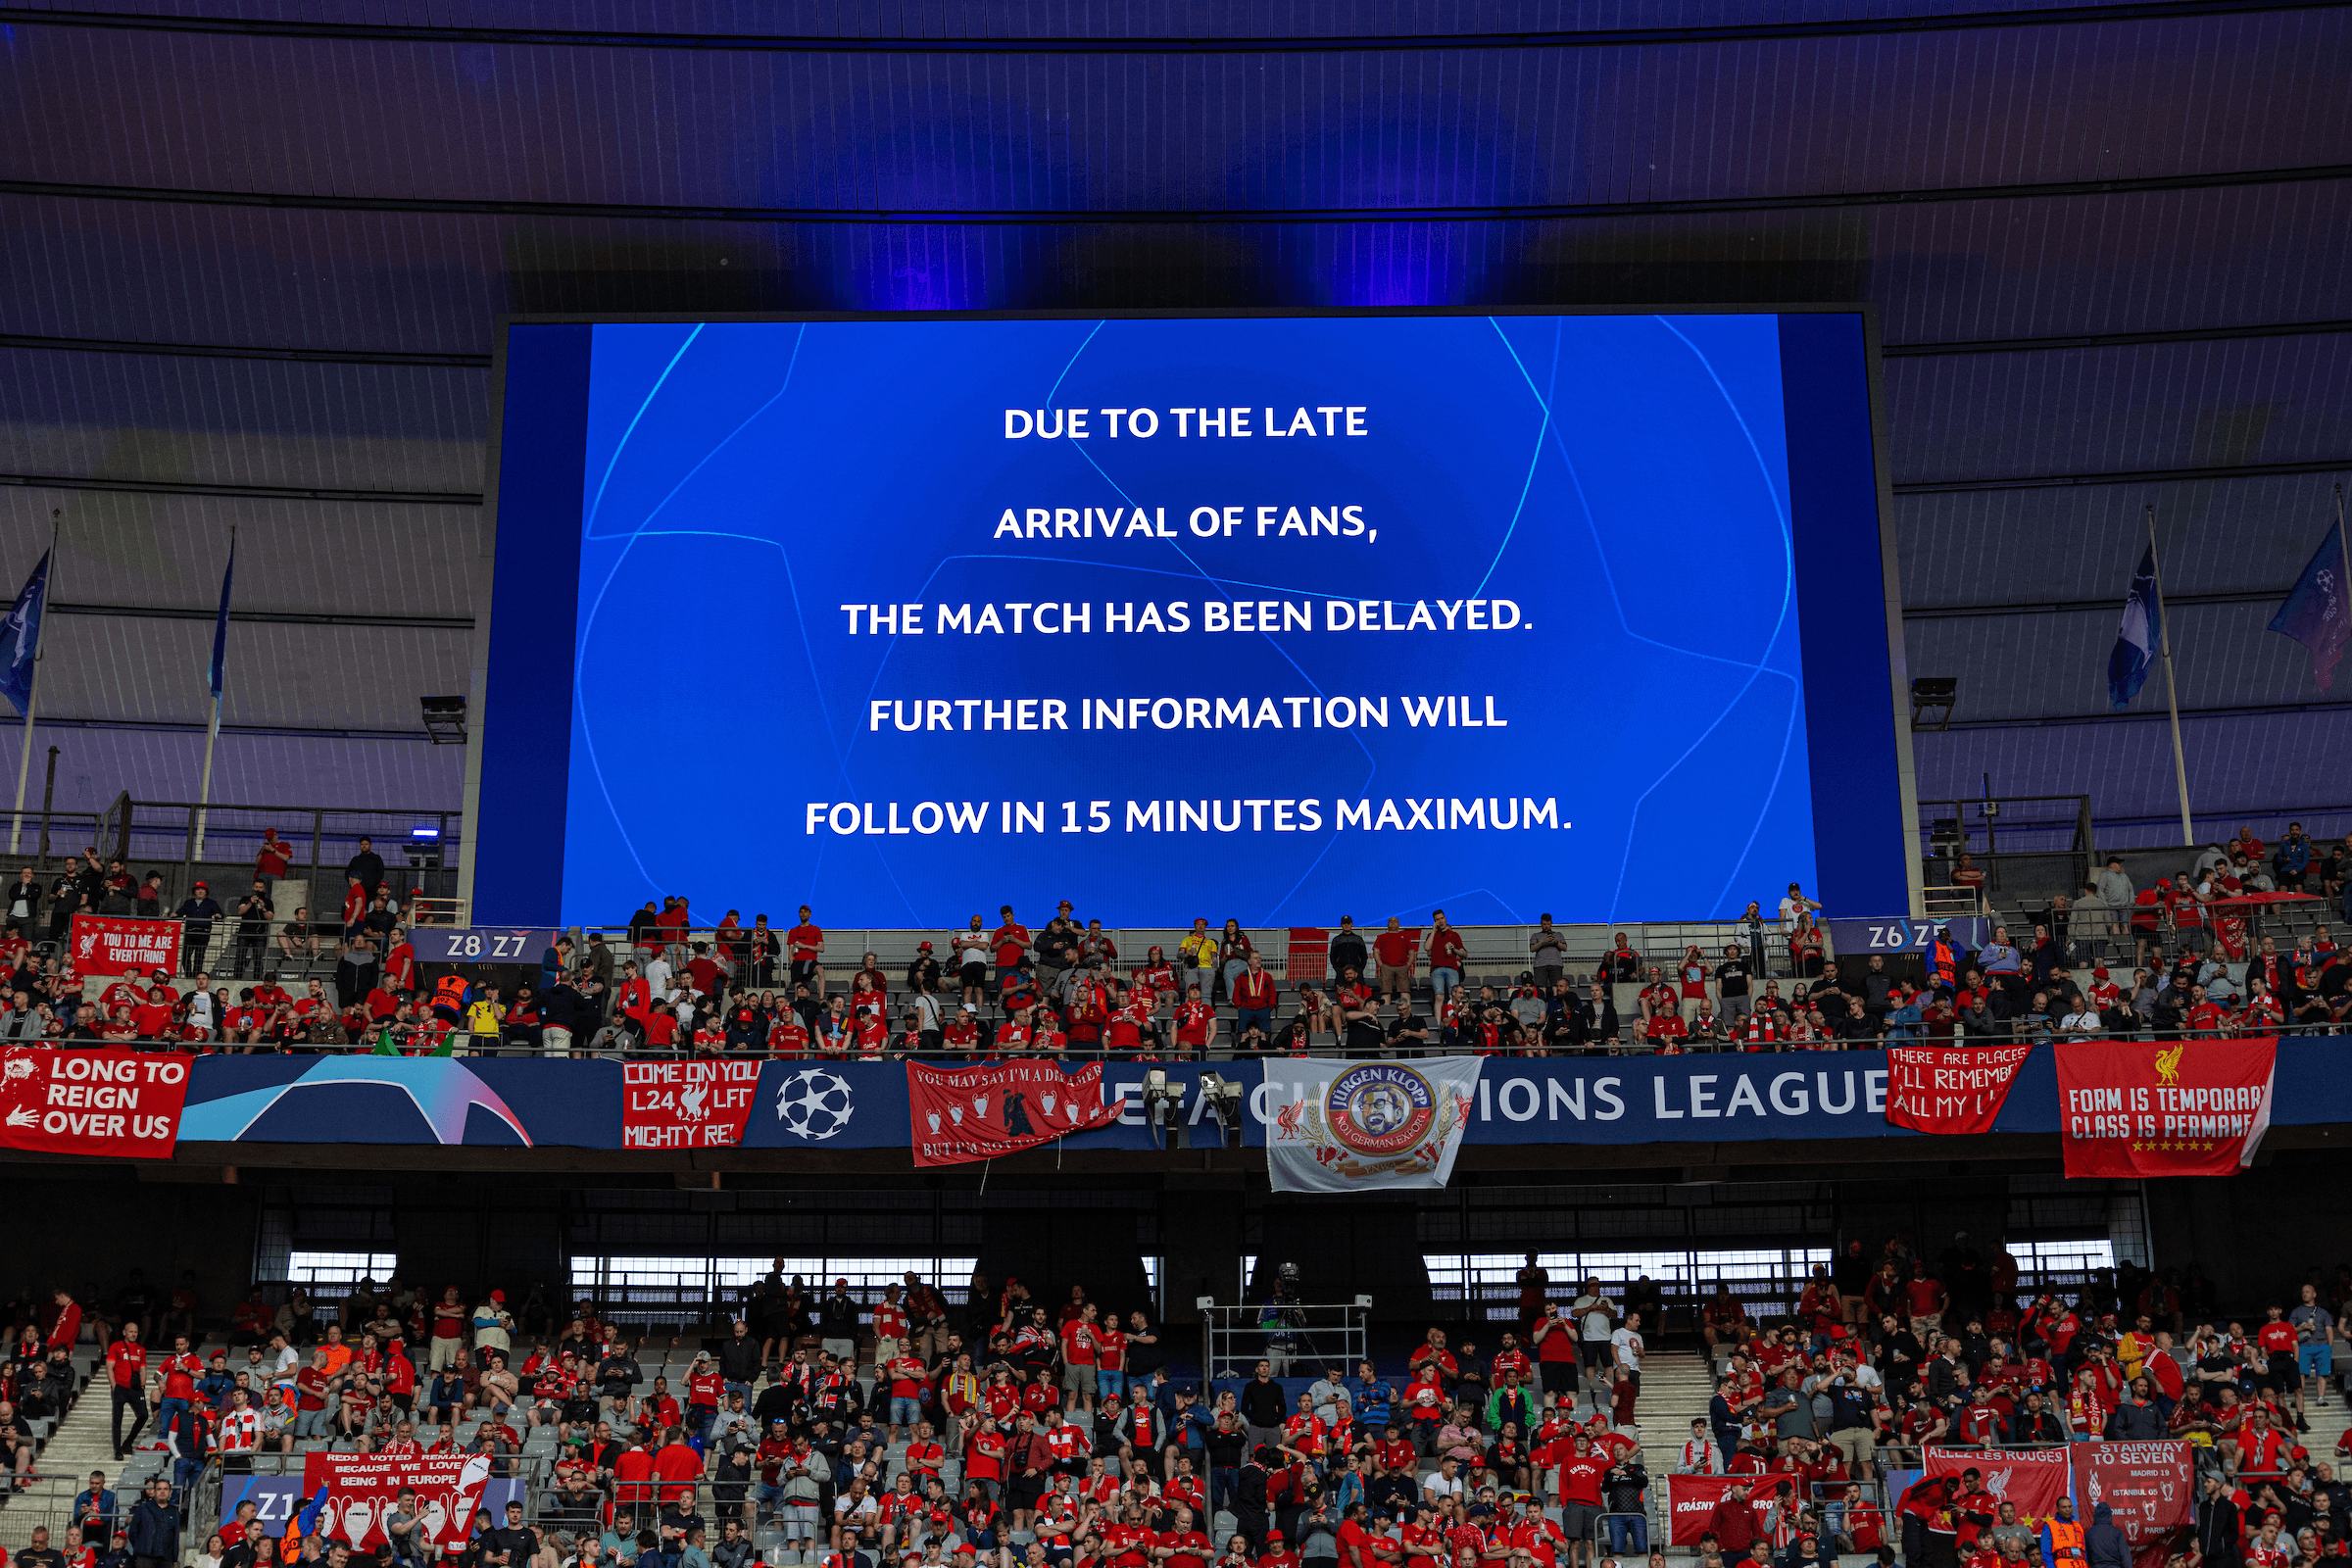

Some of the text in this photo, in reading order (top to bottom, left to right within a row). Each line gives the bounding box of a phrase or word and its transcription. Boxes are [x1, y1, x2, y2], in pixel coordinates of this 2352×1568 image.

[1005, 406, 1368, 439] DUE TO THE LATE
[994, 505, 1377, 544] ARRIVAL OF FANS,
[841, 599, 1533, 635] THE MATCH HAS BEEN DELAYED.
[870, 695, 1508, 732] FURTHER INFORMATION WILL
[806, 797, 1572, 835] FOLLOW IN 15 MINUTES MAXIMUM.
[103, 932, 173, 950] YOU TO ME ARE
[447, 935, 481, 956] Z8
[492, 936, 527, 957] Z7
[1868, 926, 1903, 948] Z6
[109, 948, 166, 964] EVERYTHING
[1891, 1047, 2026, 1065] THERE ARE PLACES
[51, 1056, 184, 1085] LONG TO
[624, 1060, 763, 1085] COME ON YOU
[916, 1070, 944, 1086] YOU
[948, 1074, 978, 1087] MAY
[981, 1071, 1006, 1086] SAY
[1008, 1068, 1030, 1082] I'M
[1032, 1069, 1042, 1082] A
[47, 1083, 139, 1109] REIGN
[1332, 1068, 1428, 1107] JÜRGEN KLOPP
[1653, 1068, 1887, 1120] LEAGUE
[2069, 1084, 2267, 1113] FORM IS TEMPORAR
[632, 1090, 675, 1111] L24
[1893, 1084, 1931, 1117] ALL
[1936, 1095, 1967, 1118] MY
[43, 1110, 171, 1140] OVER US
[1349, 1132, 1395, 1150] GERMAN
[1396, 1112, 1427, 1146] EXPORT
[2071, 1113, 2130, 1139] CLASS
[2137, 1114, 2155, 1138] IS
[624, 1125, 698, 1148] MIGHTY
[923, 1140, 1012, 1157] BUT I'M NOT
[326, 1452, 471, 1462] REDS VOTED REMAIN
[1976, 1450, 2002, 1461] LES
[2006, 1450, 2063, 1463] ROUGES
[2091, 1452, 2176, 1465] TO SEVEN
[2100, 1442, 2184, 1453] STAIRWAY
[334, 1461, 462, 1474] BECAUSE WE LOVE
[340, 1474, 457, 1487] BEING IN EUROPE
[1677, 1497, 1715, 1512] KRÁSNY
